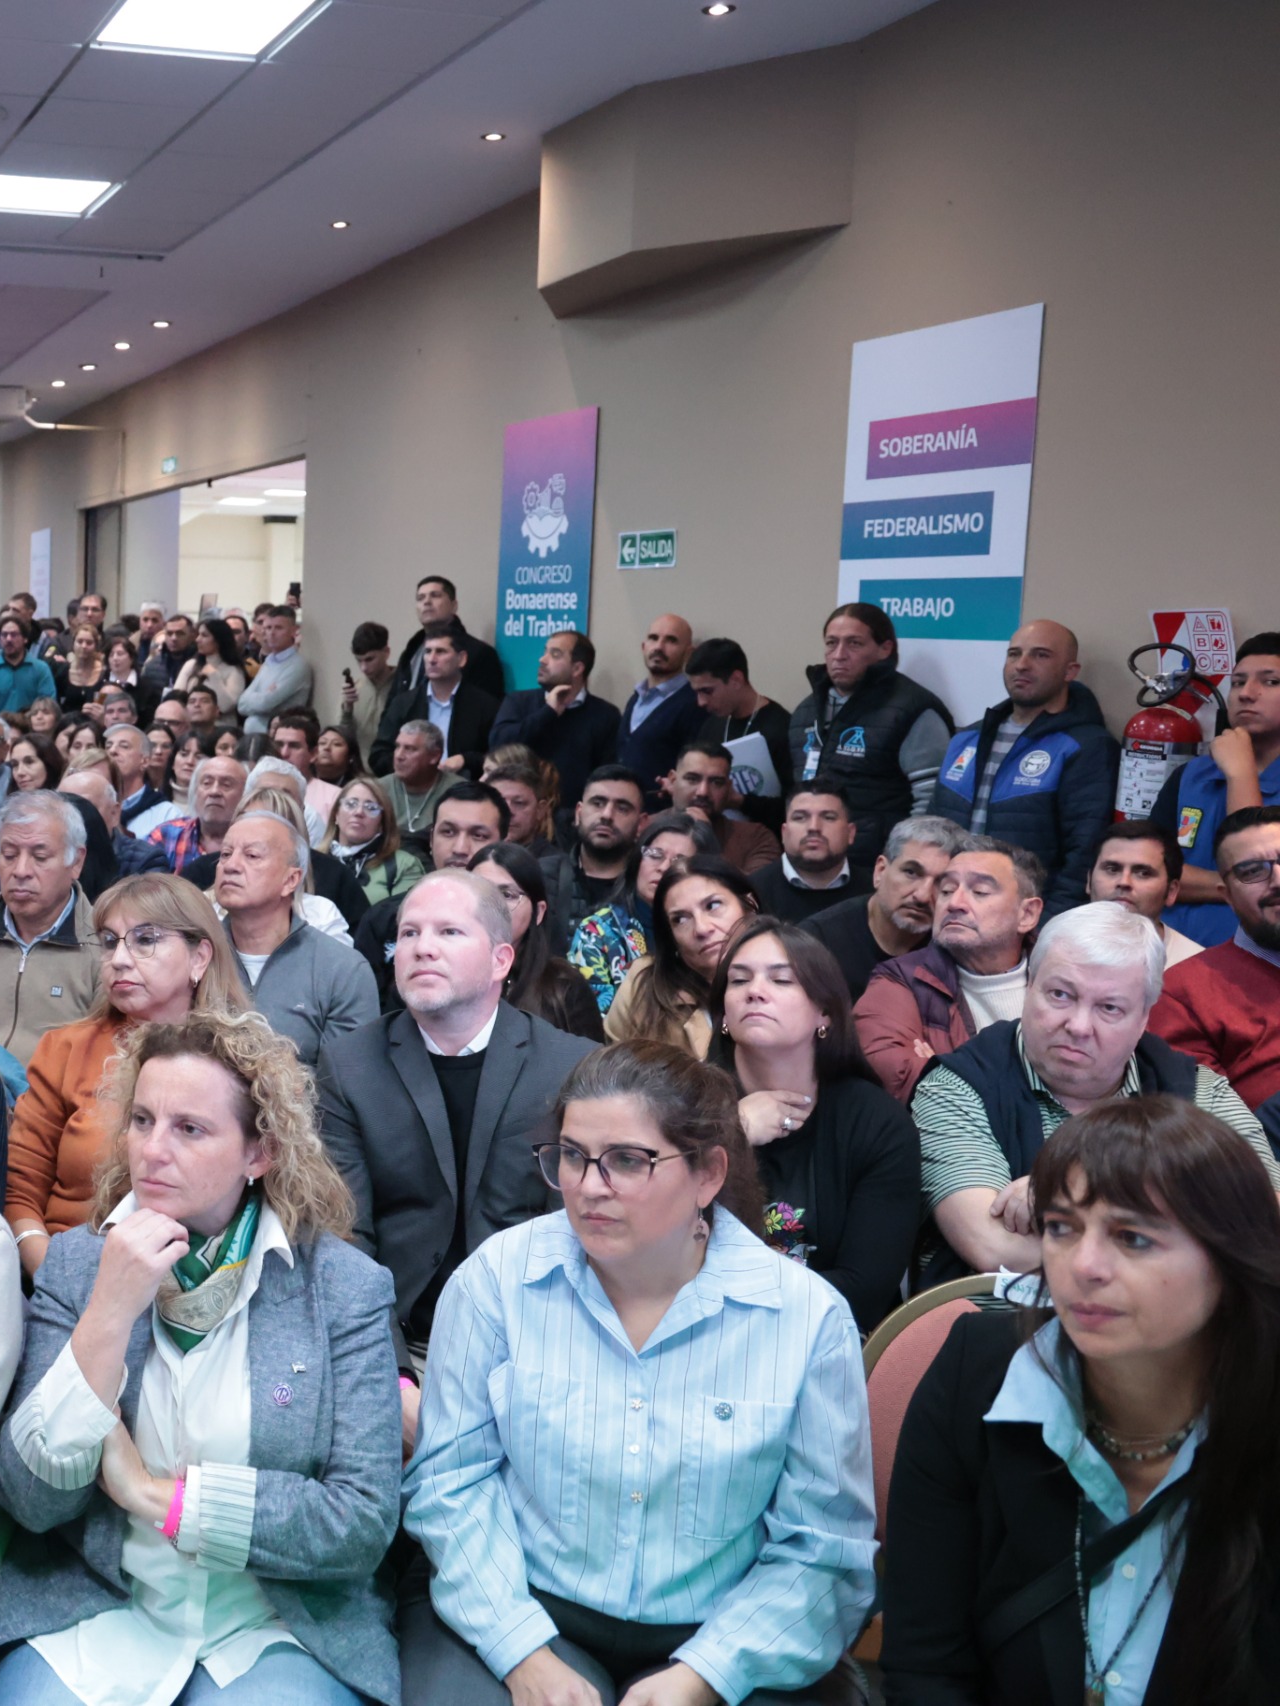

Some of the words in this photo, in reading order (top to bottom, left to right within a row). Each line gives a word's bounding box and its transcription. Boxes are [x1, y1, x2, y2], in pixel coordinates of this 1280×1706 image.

[879, 424, 978, 458] SOBERANÍA
[863, 512, 984, 538] FEDERALISMO
[640, 539, 673, 559] SALIDA
[515, 564, 572, 585] CONGRESO
[505, 588, 578, 610] Bonaerense
[880, 597, 955, 620] TRABAJO
[504, 613, 524, 636] del
[1196, 637, 1207, 647] B
[1198, 656, 1208, 668] C
